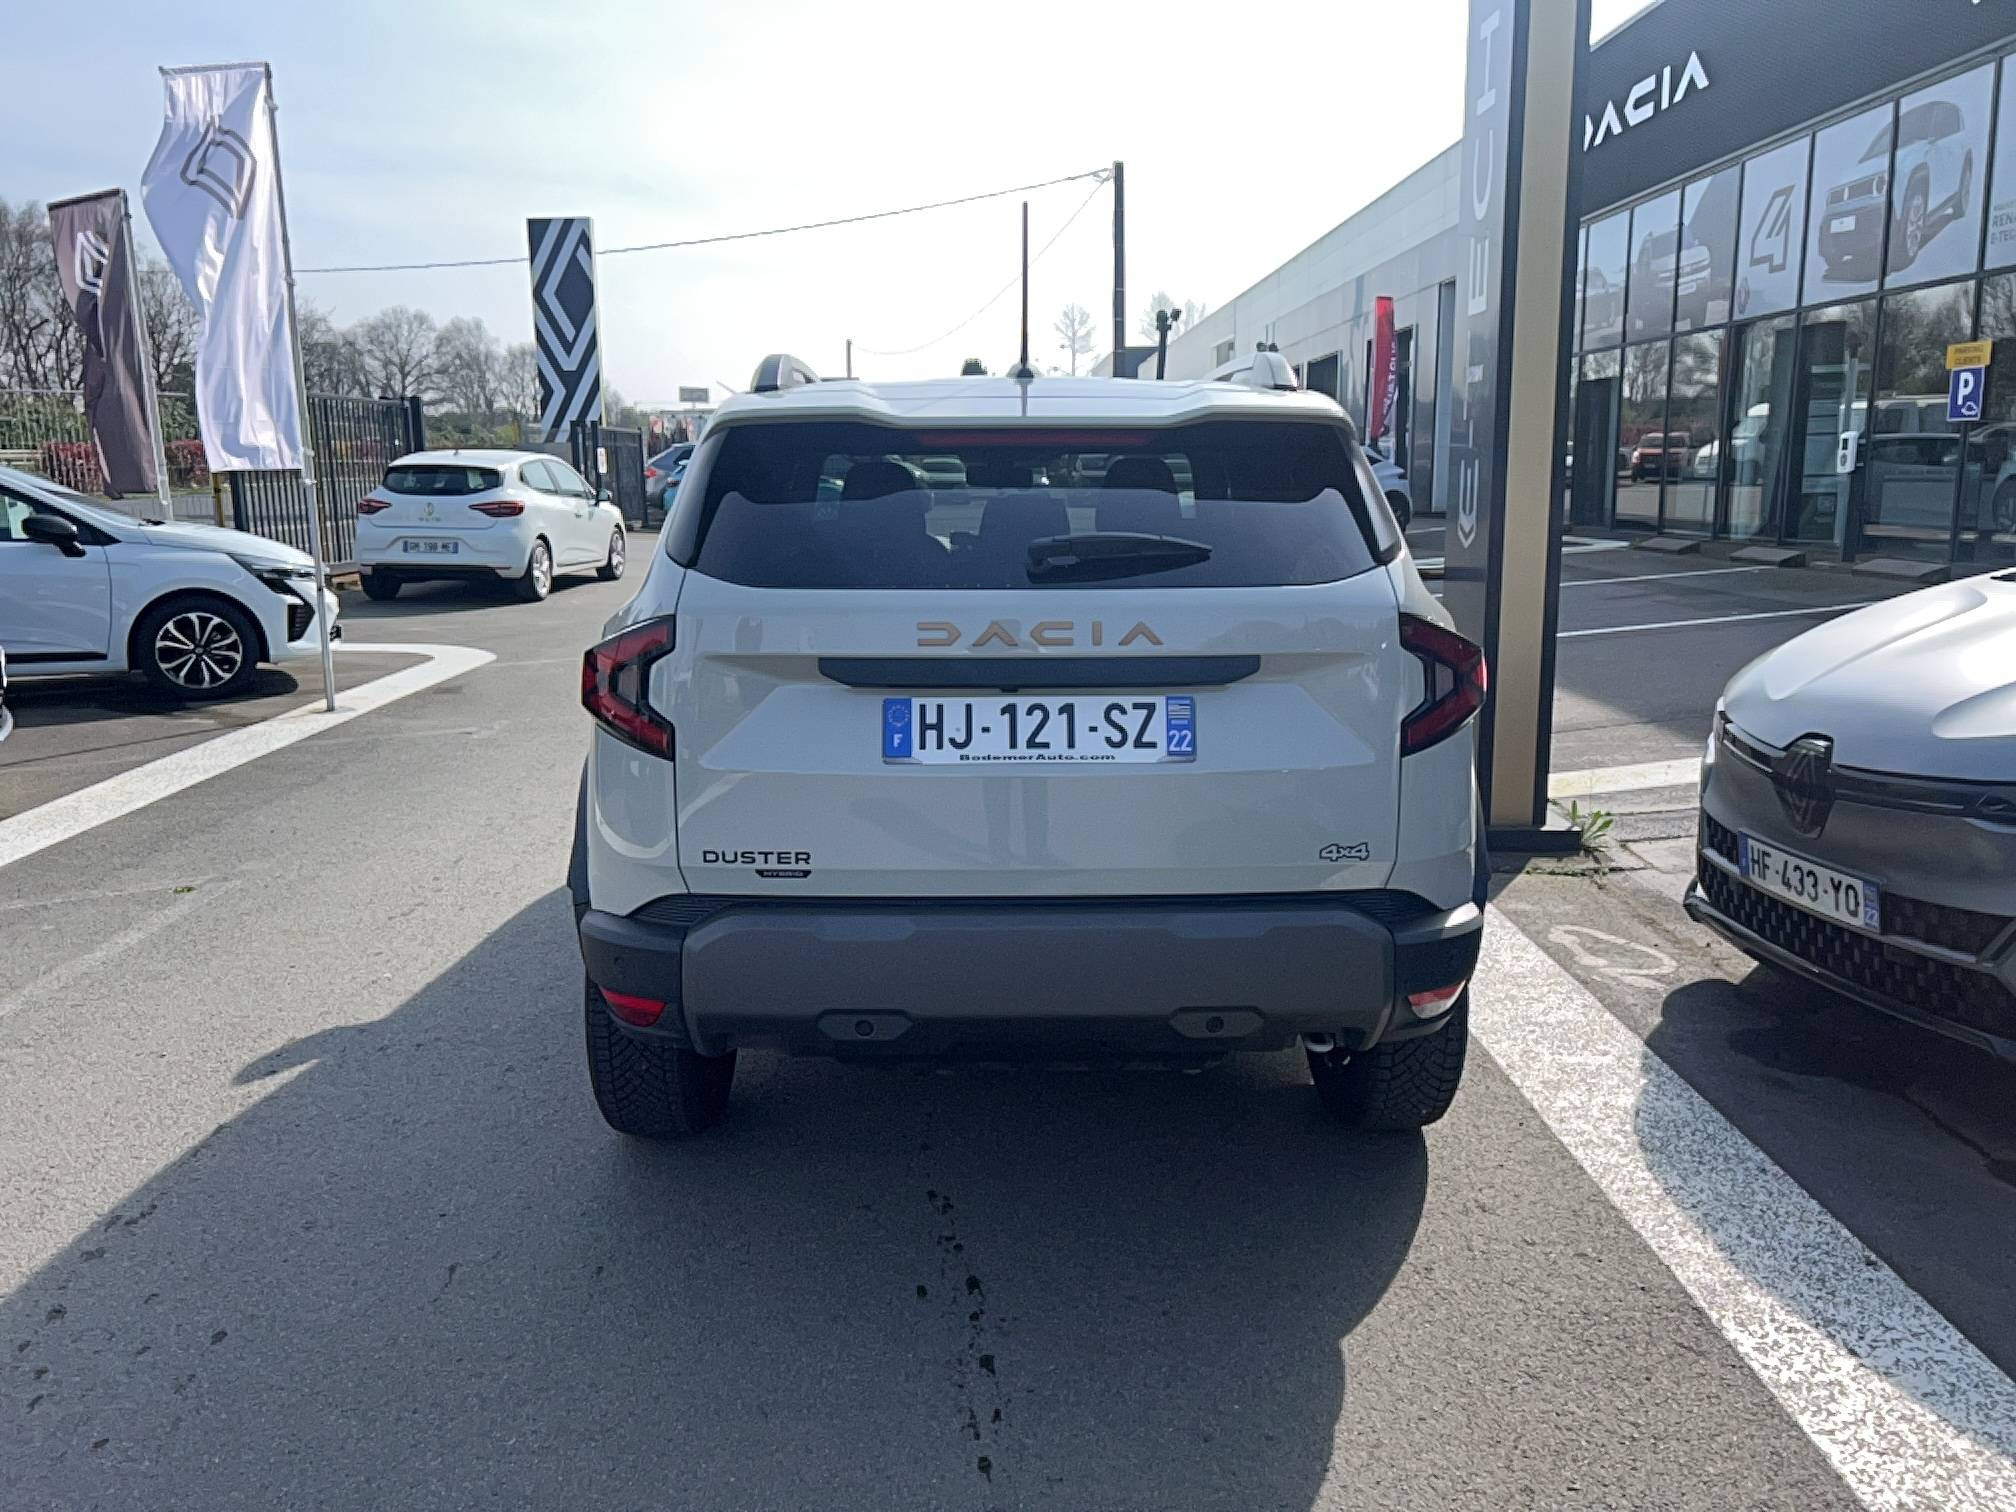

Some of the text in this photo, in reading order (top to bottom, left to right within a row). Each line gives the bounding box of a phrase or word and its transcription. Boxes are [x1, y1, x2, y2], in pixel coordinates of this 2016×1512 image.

[1957, 372, 1974, 406] P
[917, 620, 1162, 648] DACIA
[918, 701, 1158, 750] HJ-121-SZ
[892, 734, 903, 748] F
[1168, 730, 1193, 752] 22
[959, 753, 1116, 762] BodemerAuto.com
[702, 850, 812, 865] DUSTER
[1319, 841, 1370, 862] 4x4
